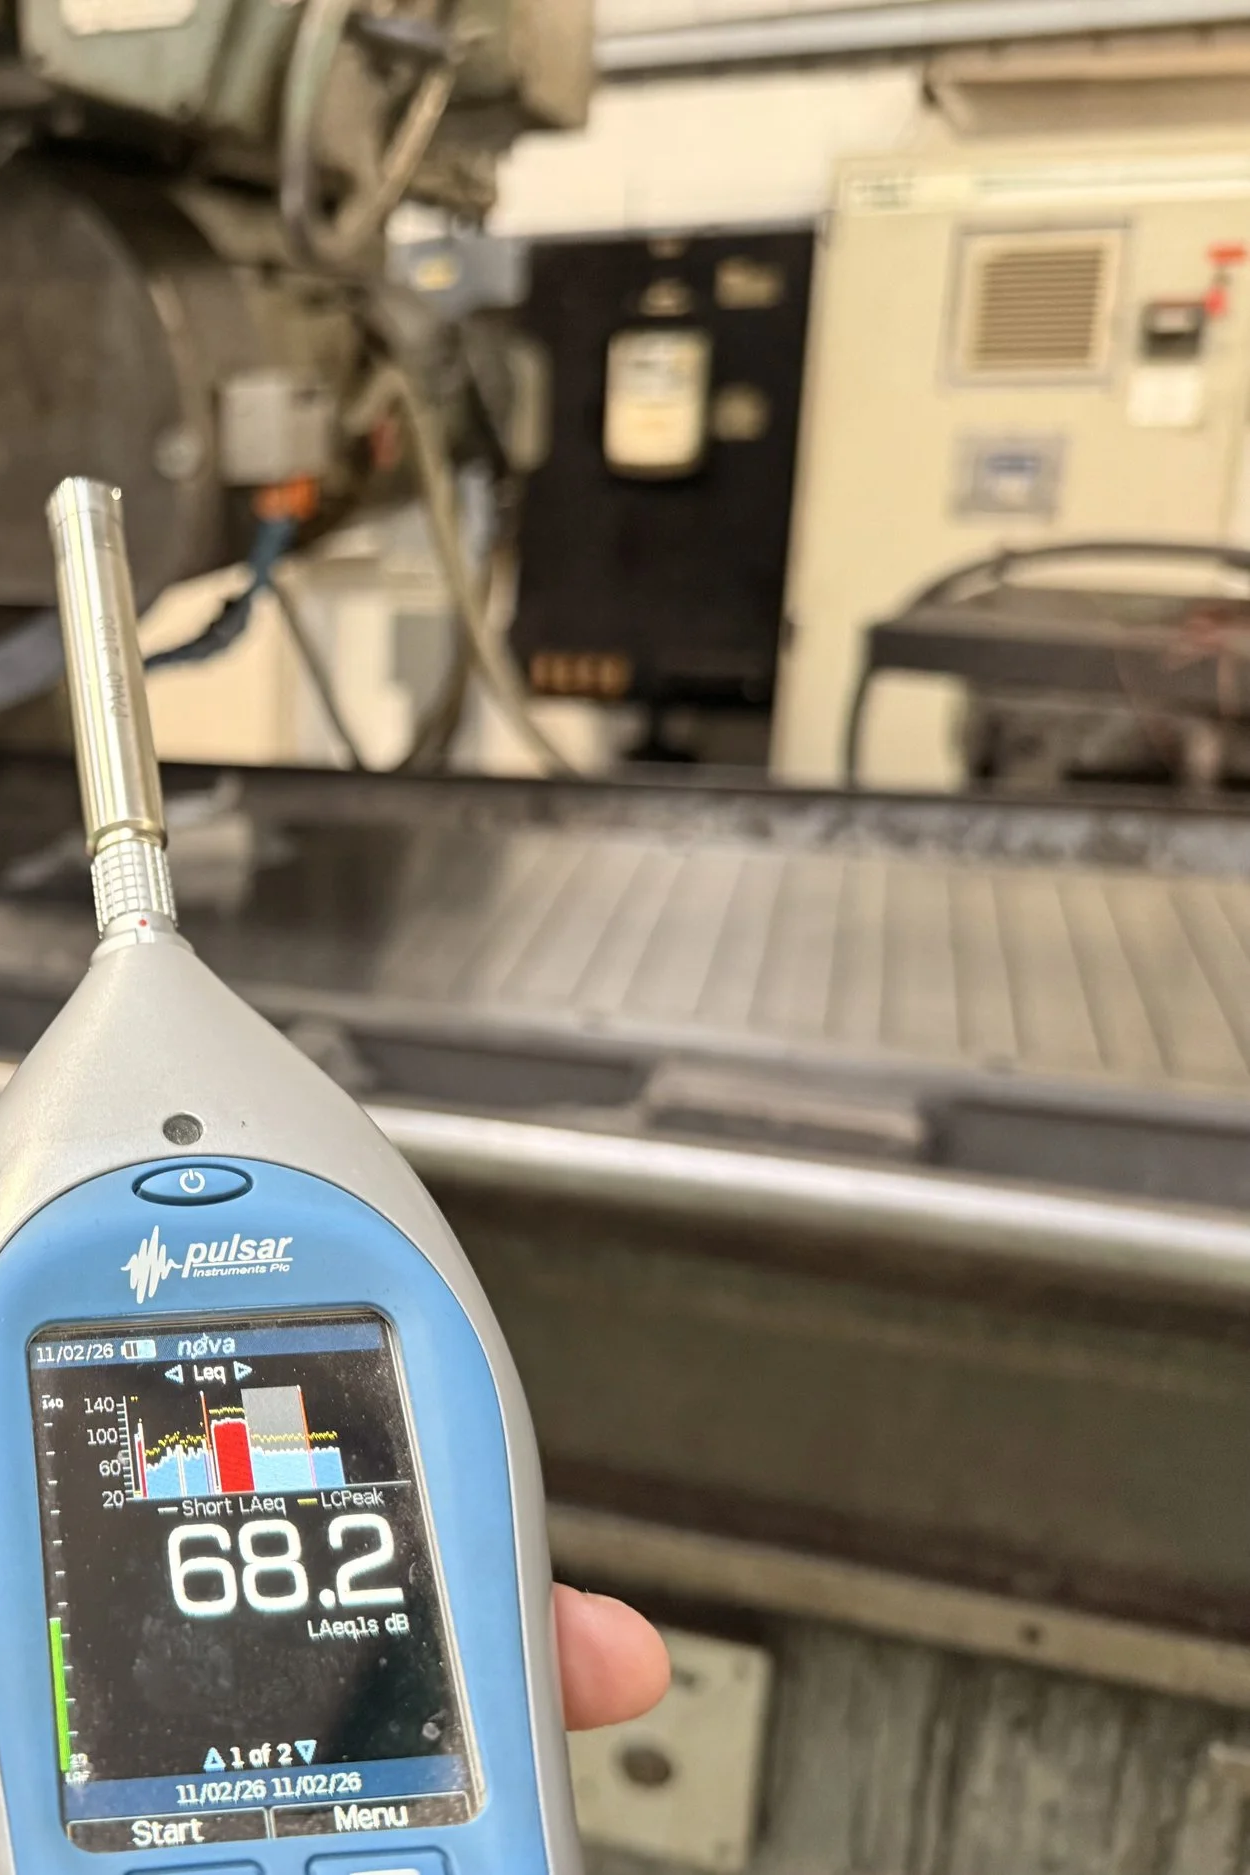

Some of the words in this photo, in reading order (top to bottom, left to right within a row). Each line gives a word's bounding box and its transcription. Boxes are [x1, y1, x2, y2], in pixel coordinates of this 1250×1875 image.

[181, 1233, 293, 1278] pulsar
[193, 1265, 267, 1277] Instruments
[270, 1263, 290, 1273] Plc
[37, 1343, 114, 1363] 11/02/26
[193, 1364, 226, 1384] Leq
[42, 1398, 64, 1410] 140
[84, 1396, 115, 1413] 140
[87, 1427, 118, 1445] 100
[99, 1459, 121, 1476] 60
[102, 1490, 124, 1507] 20
[182, 1498, 233, 1517] Short
[239, 1496, 287, 1517] LAeq
[321, 1487, 385, 1509] LCPeak
[167, 1512, 404, 1617] 68.2
[384, 1612, 410, 1634] dB
[230, 1746, 245, 1768] 1
[249, 1742, 272, 1767] of
[276, 1741, 293, 1766] 2
[175, 1779, 267, 1806] 11/02/26
[270, 1771, 362, 1799] 11/02/26
[131, 1817, 205, 1847] Start
[334, 1804, 409, 1832] Menu
